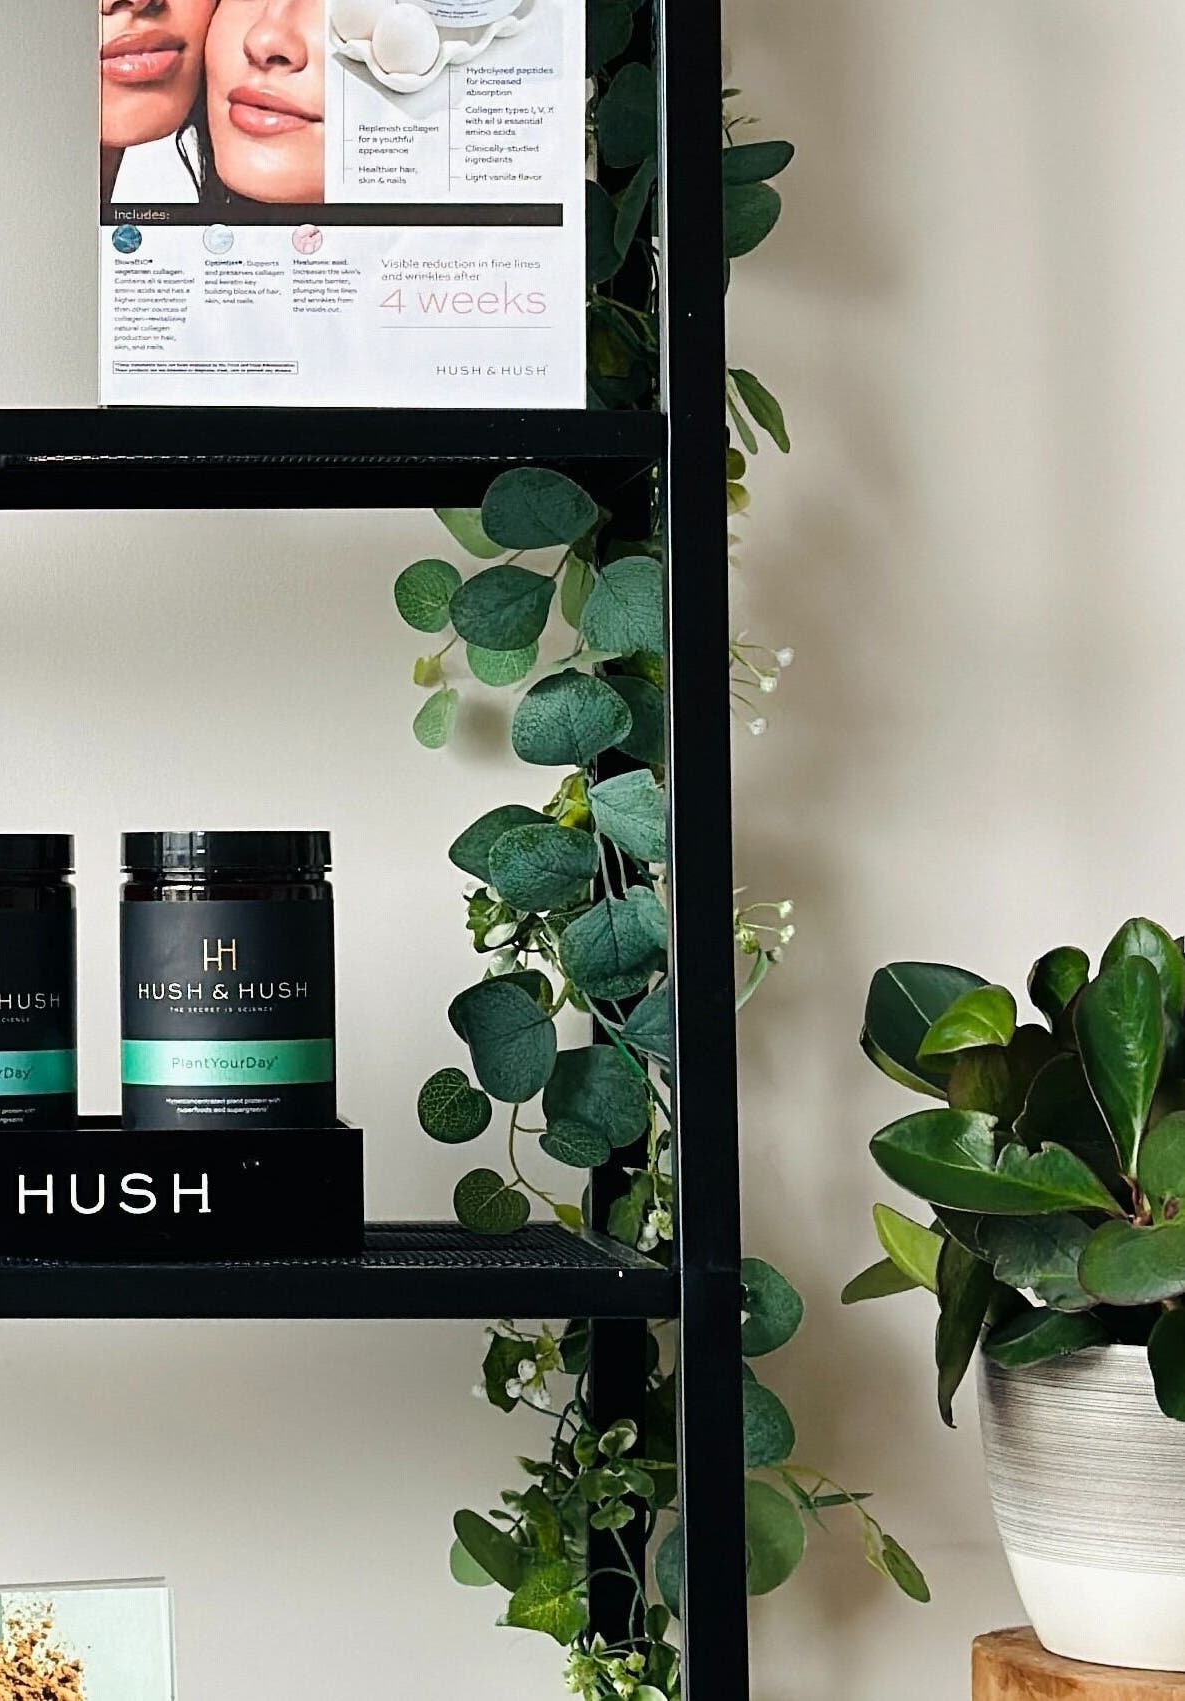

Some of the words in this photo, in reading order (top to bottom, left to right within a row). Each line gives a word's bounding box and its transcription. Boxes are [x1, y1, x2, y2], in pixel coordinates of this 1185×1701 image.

[465, 106, 503, 115] Collagen
[358, 135, 370, 143] for
[465, 156, 513, 164] ingredients
[466, 173, 487, 182] Light
[114, 209, 170, 220] Includes:
[381, 259, 420, 269] Visible
[422, 259, 476, 269] reduction
[478, 259, 488, 269] in
[491, 259, 511, 269] fine
[514, 259, 541, 269] lines
[381, 271, 403, 281] and
[405, 271, 451, 281] wrinkles
[453, 271, 480, 281] after
[379, 288, 407, 314] 4
[417, 280, 547, 314] weeks
[436, 365, 481, 376] HUSH
[486, 365, 496, 376] &
[502, 365, 547, 376] HUSH
[138, 982, 202, 1000] HUSH
[212, 983, 229, 1000] &
[239, 981, 308, 1000] HUSH
[18, 1173, 212, 1214] HUSH
